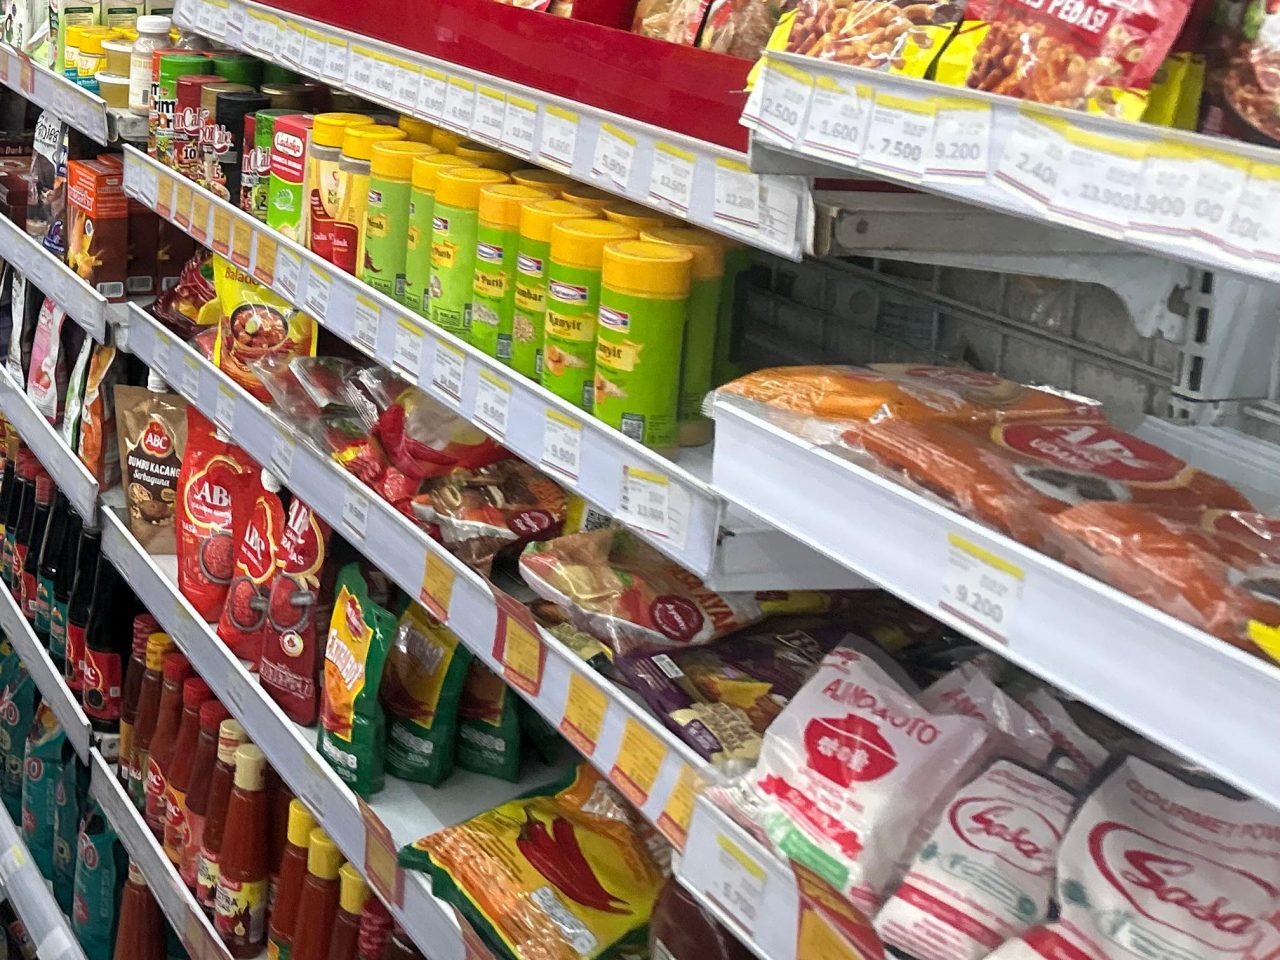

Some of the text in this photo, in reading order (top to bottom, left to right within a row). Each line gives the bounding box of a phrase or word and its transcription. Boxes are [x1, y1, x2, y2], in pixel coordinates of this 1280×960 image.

[183, 148, 197, 160] 10
[880, 138, 922, 162] 7.500
[935, 142, 980, 160] 9.200
[146, 435, 168, 450] ABC
[128, 455, 180, 478] BUMBU KACANG
[955, 582, 1004, 625] 9.200
[968, 805, 1043, 860] Sasa
[1122, 849, 1257, 937] Sasa
